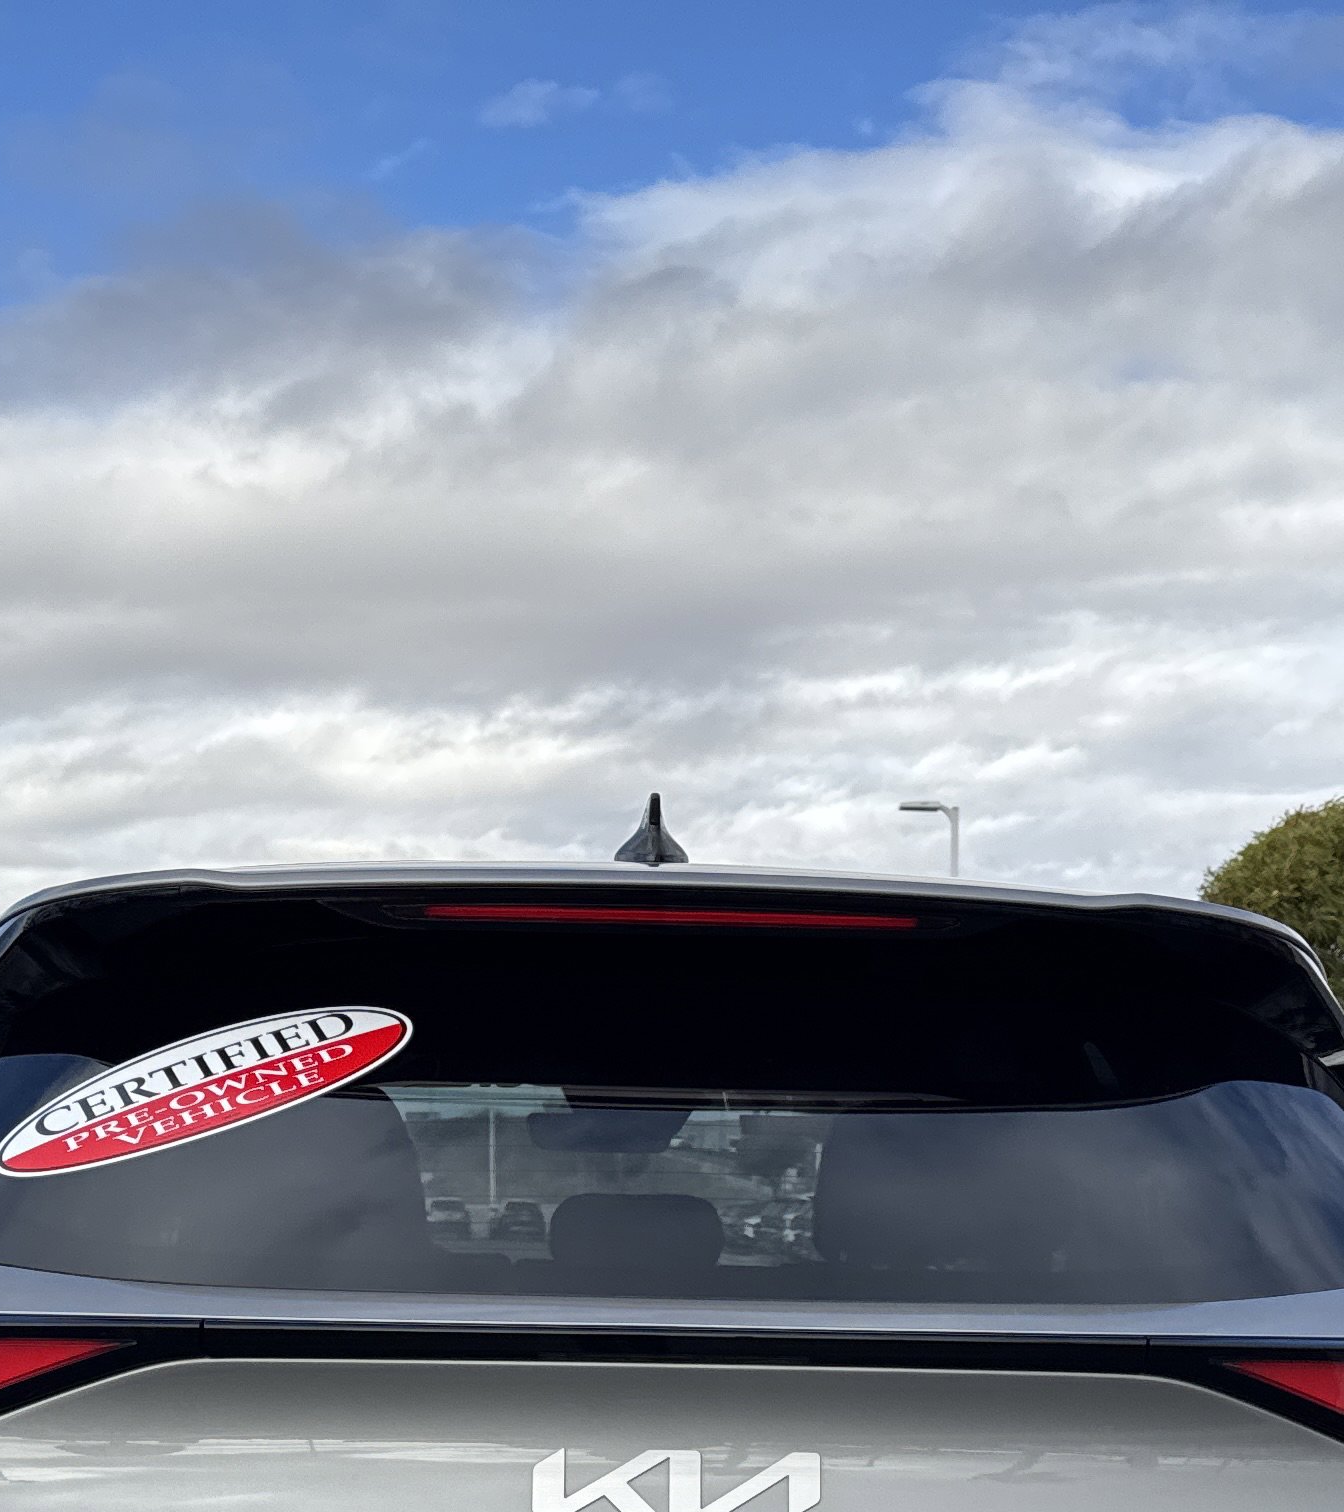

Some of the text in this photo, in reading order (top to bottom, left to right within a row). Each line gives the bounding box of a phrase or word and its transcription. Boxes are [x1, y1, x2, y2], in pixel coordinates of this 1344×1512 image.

[34, 1013, 354, 1137] CERTIFIED
[61, 1043, 354, 1153] PRE-OWNED
[112, 1068, 326, 1146] VEHICLE
